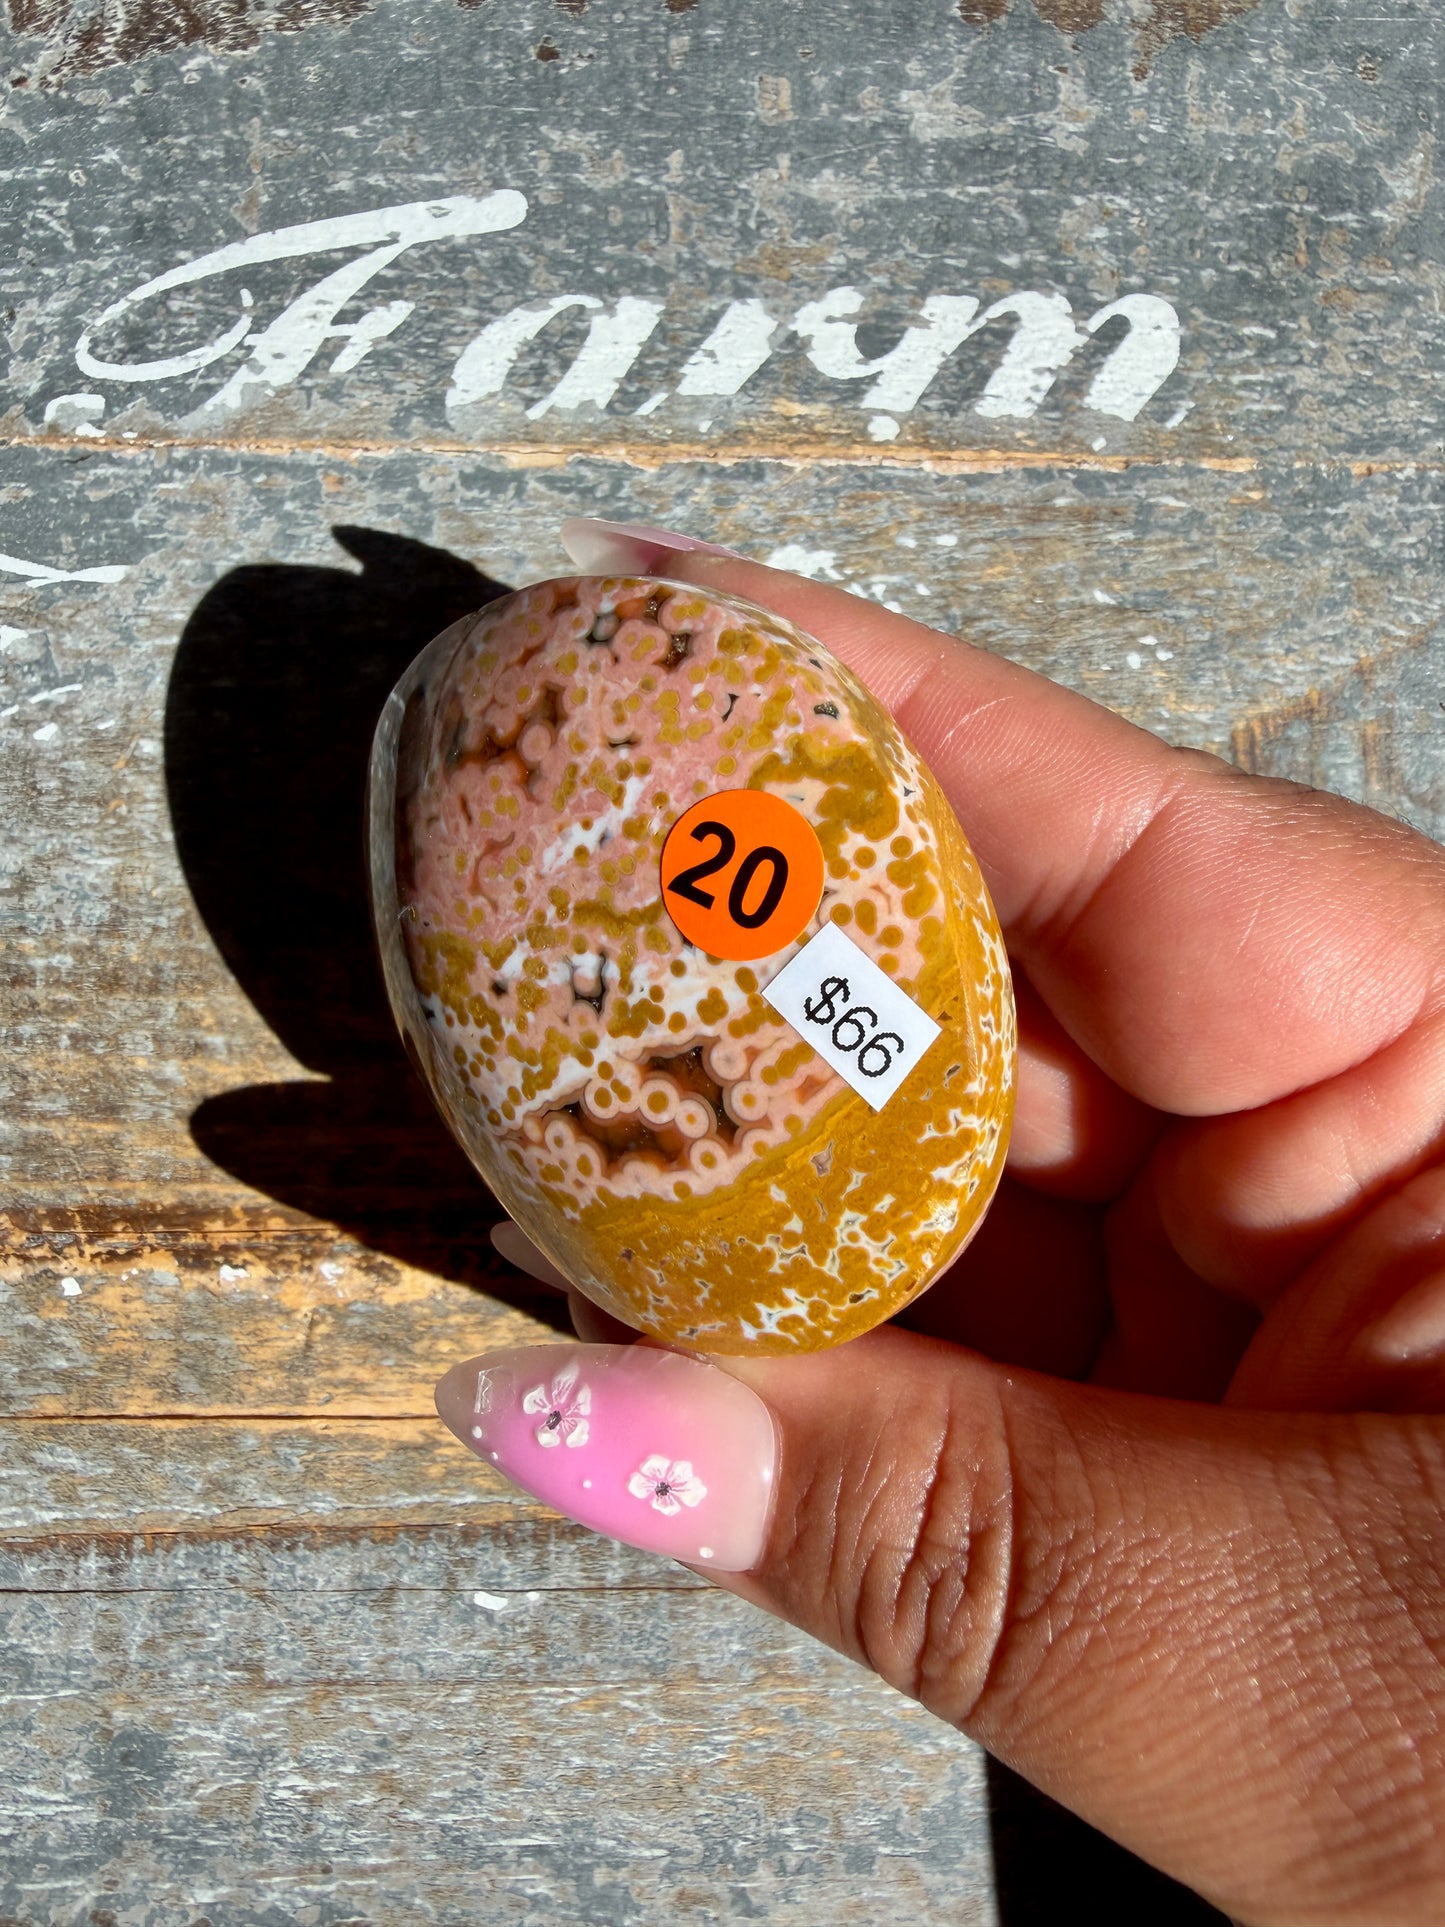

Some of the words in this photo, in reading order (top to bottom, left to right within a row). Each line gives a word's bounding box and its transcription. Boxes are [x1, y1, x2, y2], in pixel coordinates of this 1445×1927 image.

[45, 189, 1190, 438] Farm
[666, 820, 789, 929] 20
[804, 976, 904, 1078] $66
